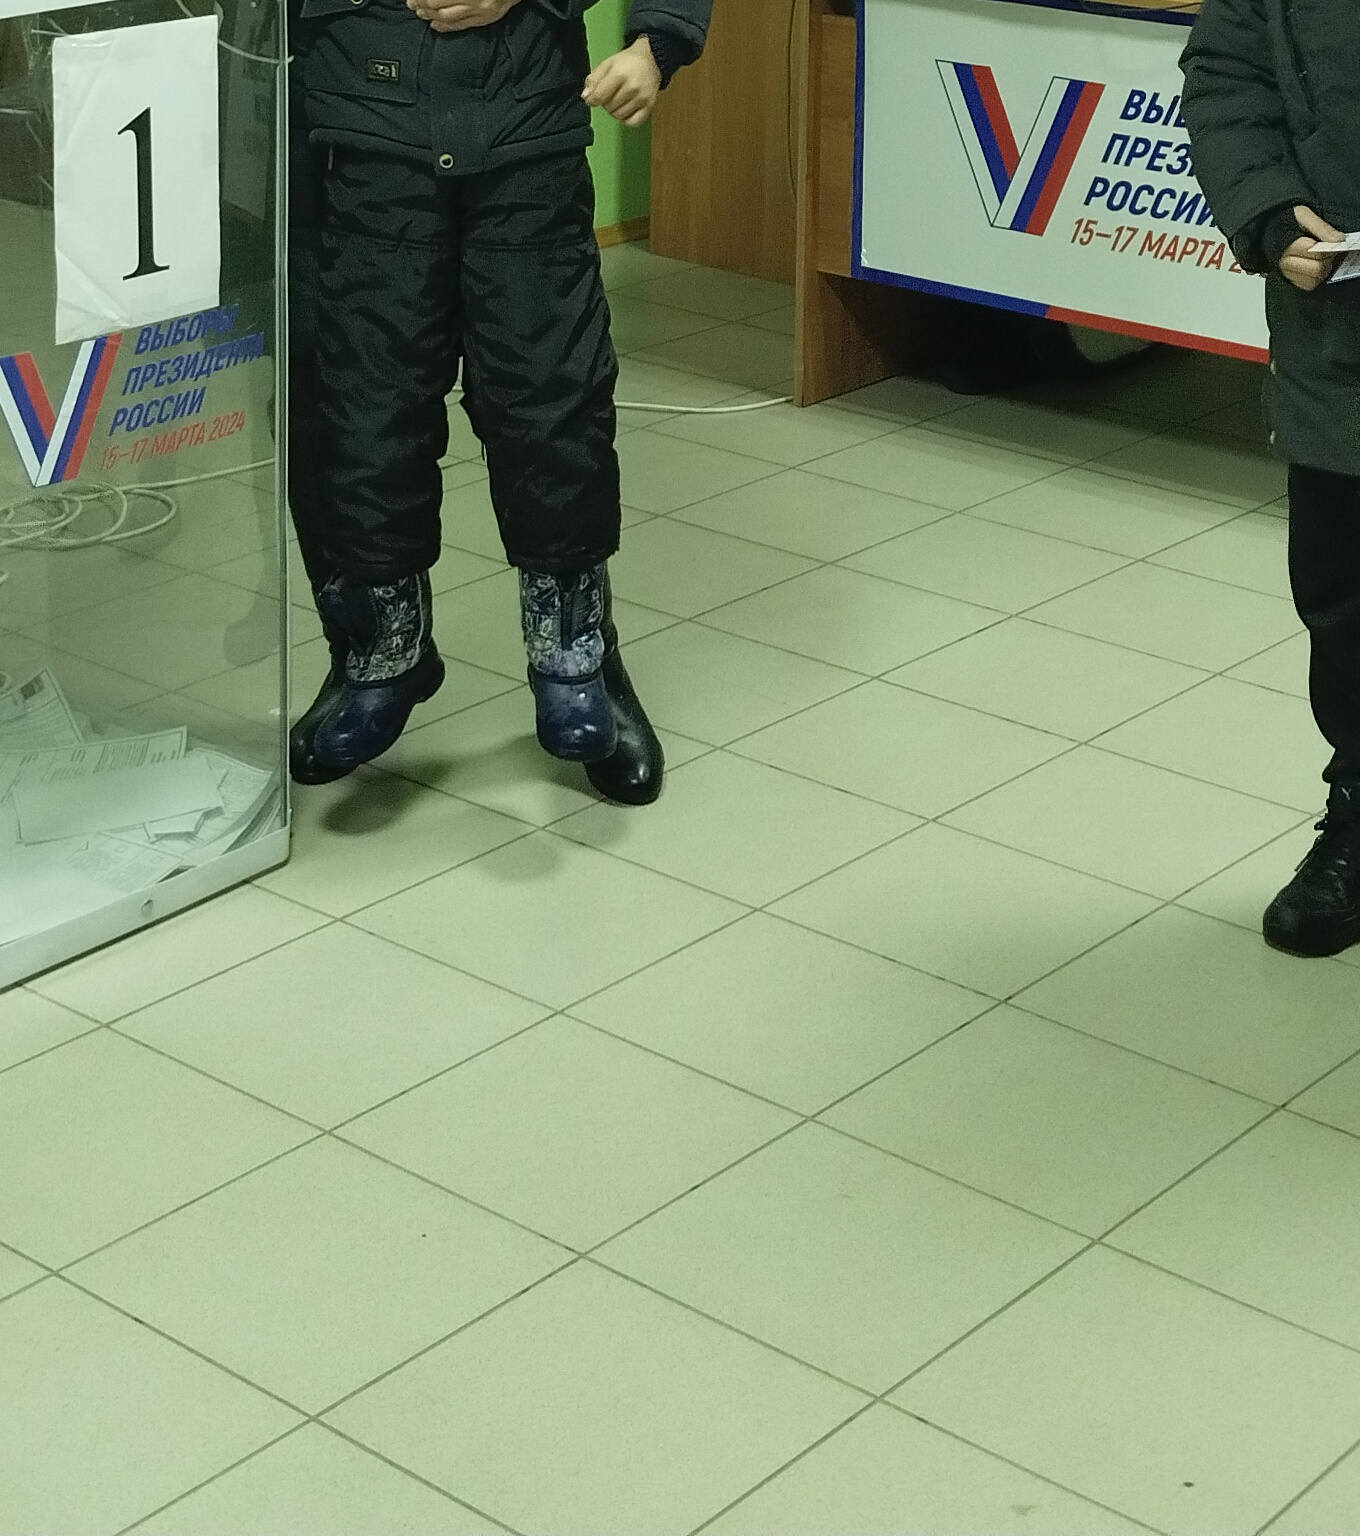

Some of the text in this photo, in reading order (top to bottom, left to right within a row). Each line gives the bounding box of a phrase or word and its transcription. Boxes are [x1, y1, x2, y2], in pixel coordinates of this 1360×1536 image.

[117, 107, 170, 280] 1
[1138, 229, 1226, 270] МАРТА
[134, 304, 240, 355] ВЫБОРЫ
[109, 386, 207, 437] РОССИИ
[150, 421, 206, 457] МАРТА
[208, 410, 246, 441] 2024
